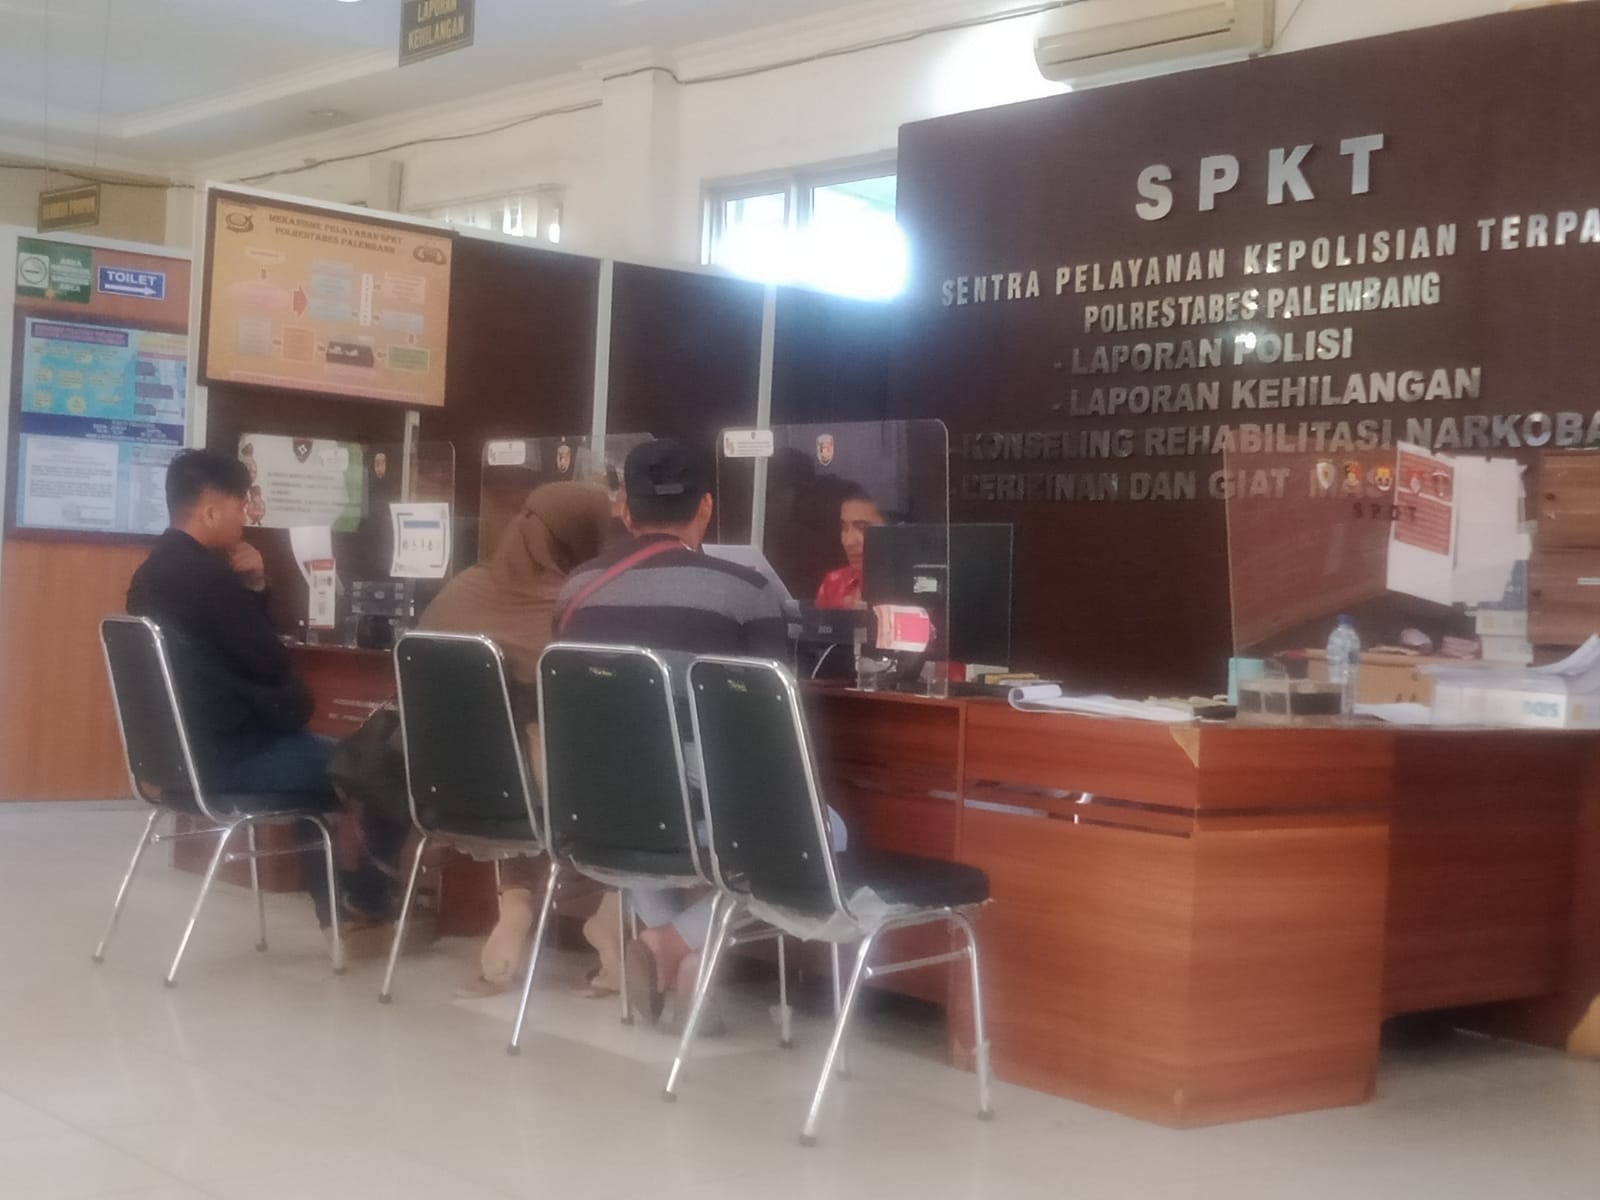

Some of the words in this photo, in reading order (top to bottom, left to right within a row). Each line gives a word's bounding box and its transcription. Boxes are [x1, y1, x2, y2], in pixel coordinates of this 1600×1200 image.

[1136, 134, 1384, 221] SPKT
[106, 270, 157, 286] TOILET
[942, 270, 1040, 306] SENTRA
[1055, 248, 1226, 296] PELAYANAN
[1243, 223, 1457, 276] KEPOLISIAN
[1084, 287, 1259, 334] POLRESTABES
[1266, 272, 1441, 319] PALEMBANG
[1071, 338, 1222, 375] LAPORAN
[1233, 327, 1354, 366] POLISI
[1069, 381, 1220, 417] LAPORAN
[1231, 367, 1482, 410] KEHILANGAN
[1144, 418, 1394, 456] REHABILITASI
[1129, 471, 1197, 501] DAN
[1208, 467, 1291, 500] GIAT
